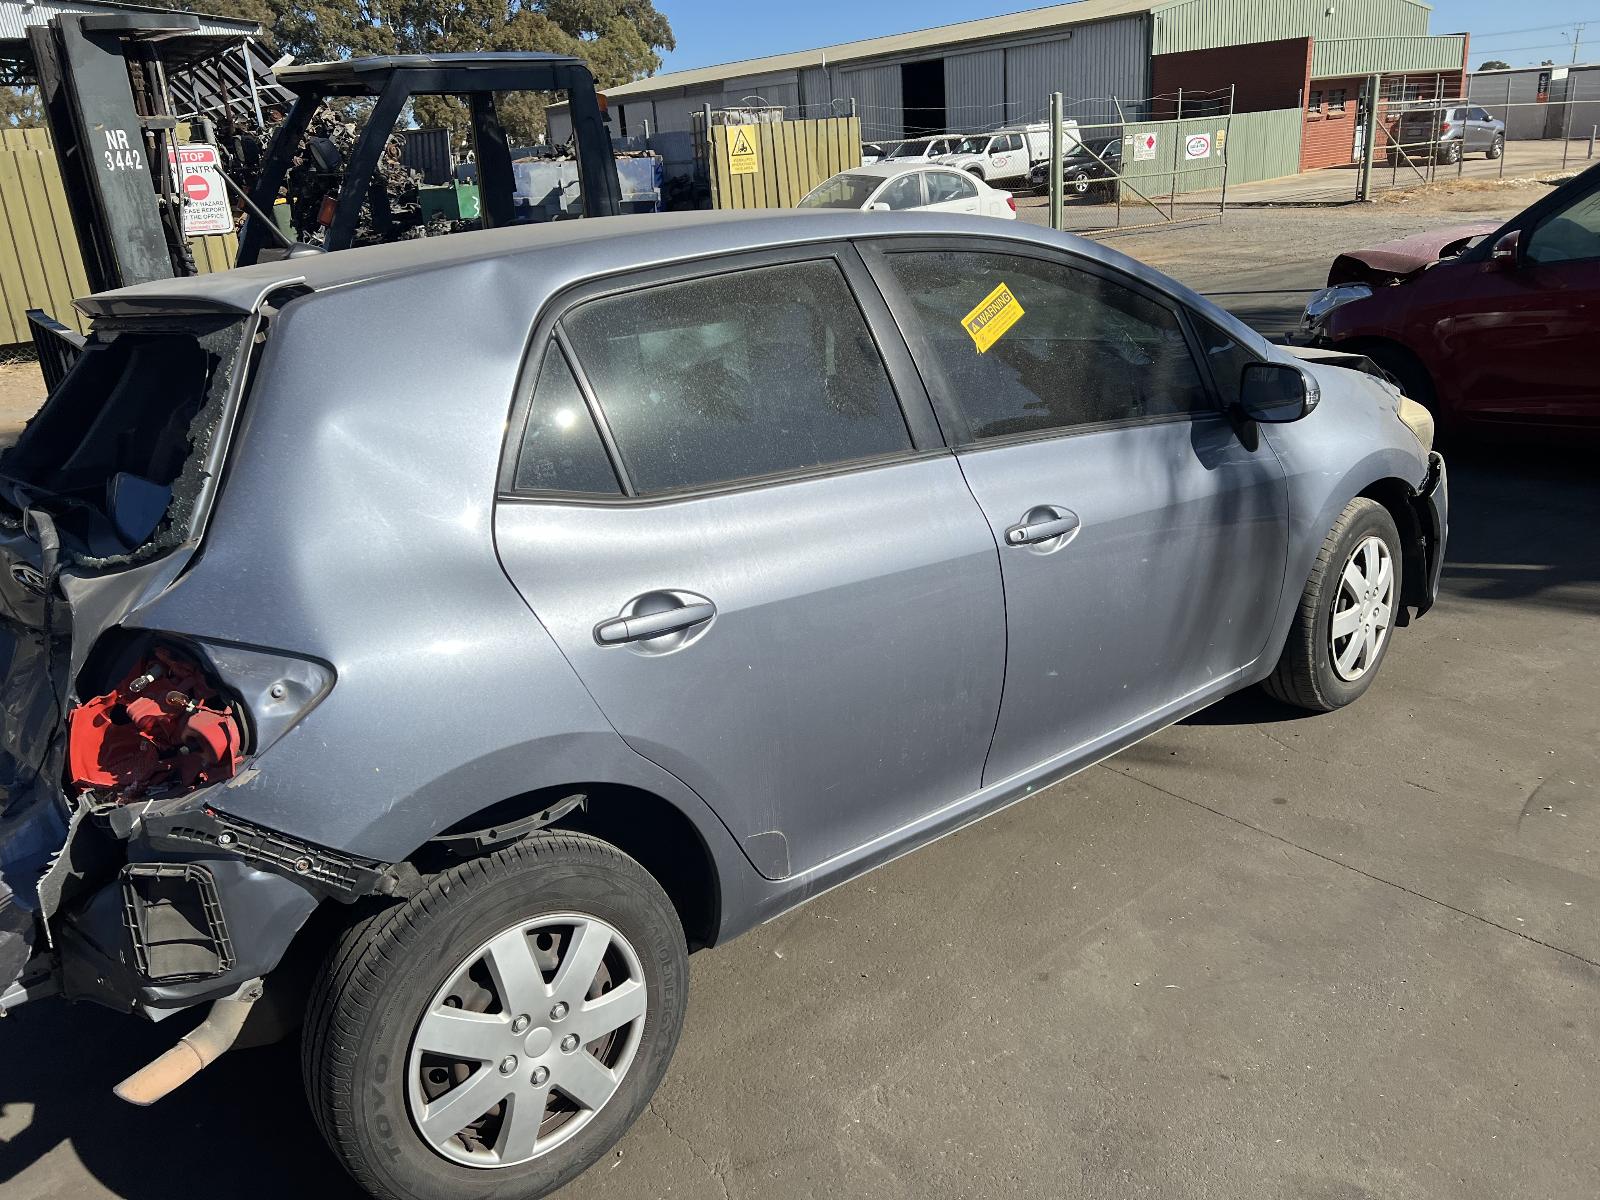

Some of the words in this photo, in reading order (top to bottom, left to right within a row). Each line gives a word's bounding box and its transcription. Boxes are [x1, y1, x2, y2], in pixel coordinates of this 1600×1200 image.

[105, 129, 130, 150] NR
[104, 149, 143, 171] 3442
[186, 165, 215, 174] ENTRY
[977, 292, 1011, 326] WARNING
[646, 915, 675, 1041] ANOENERGY
[371, 1053, 403, 1162] TOYO
